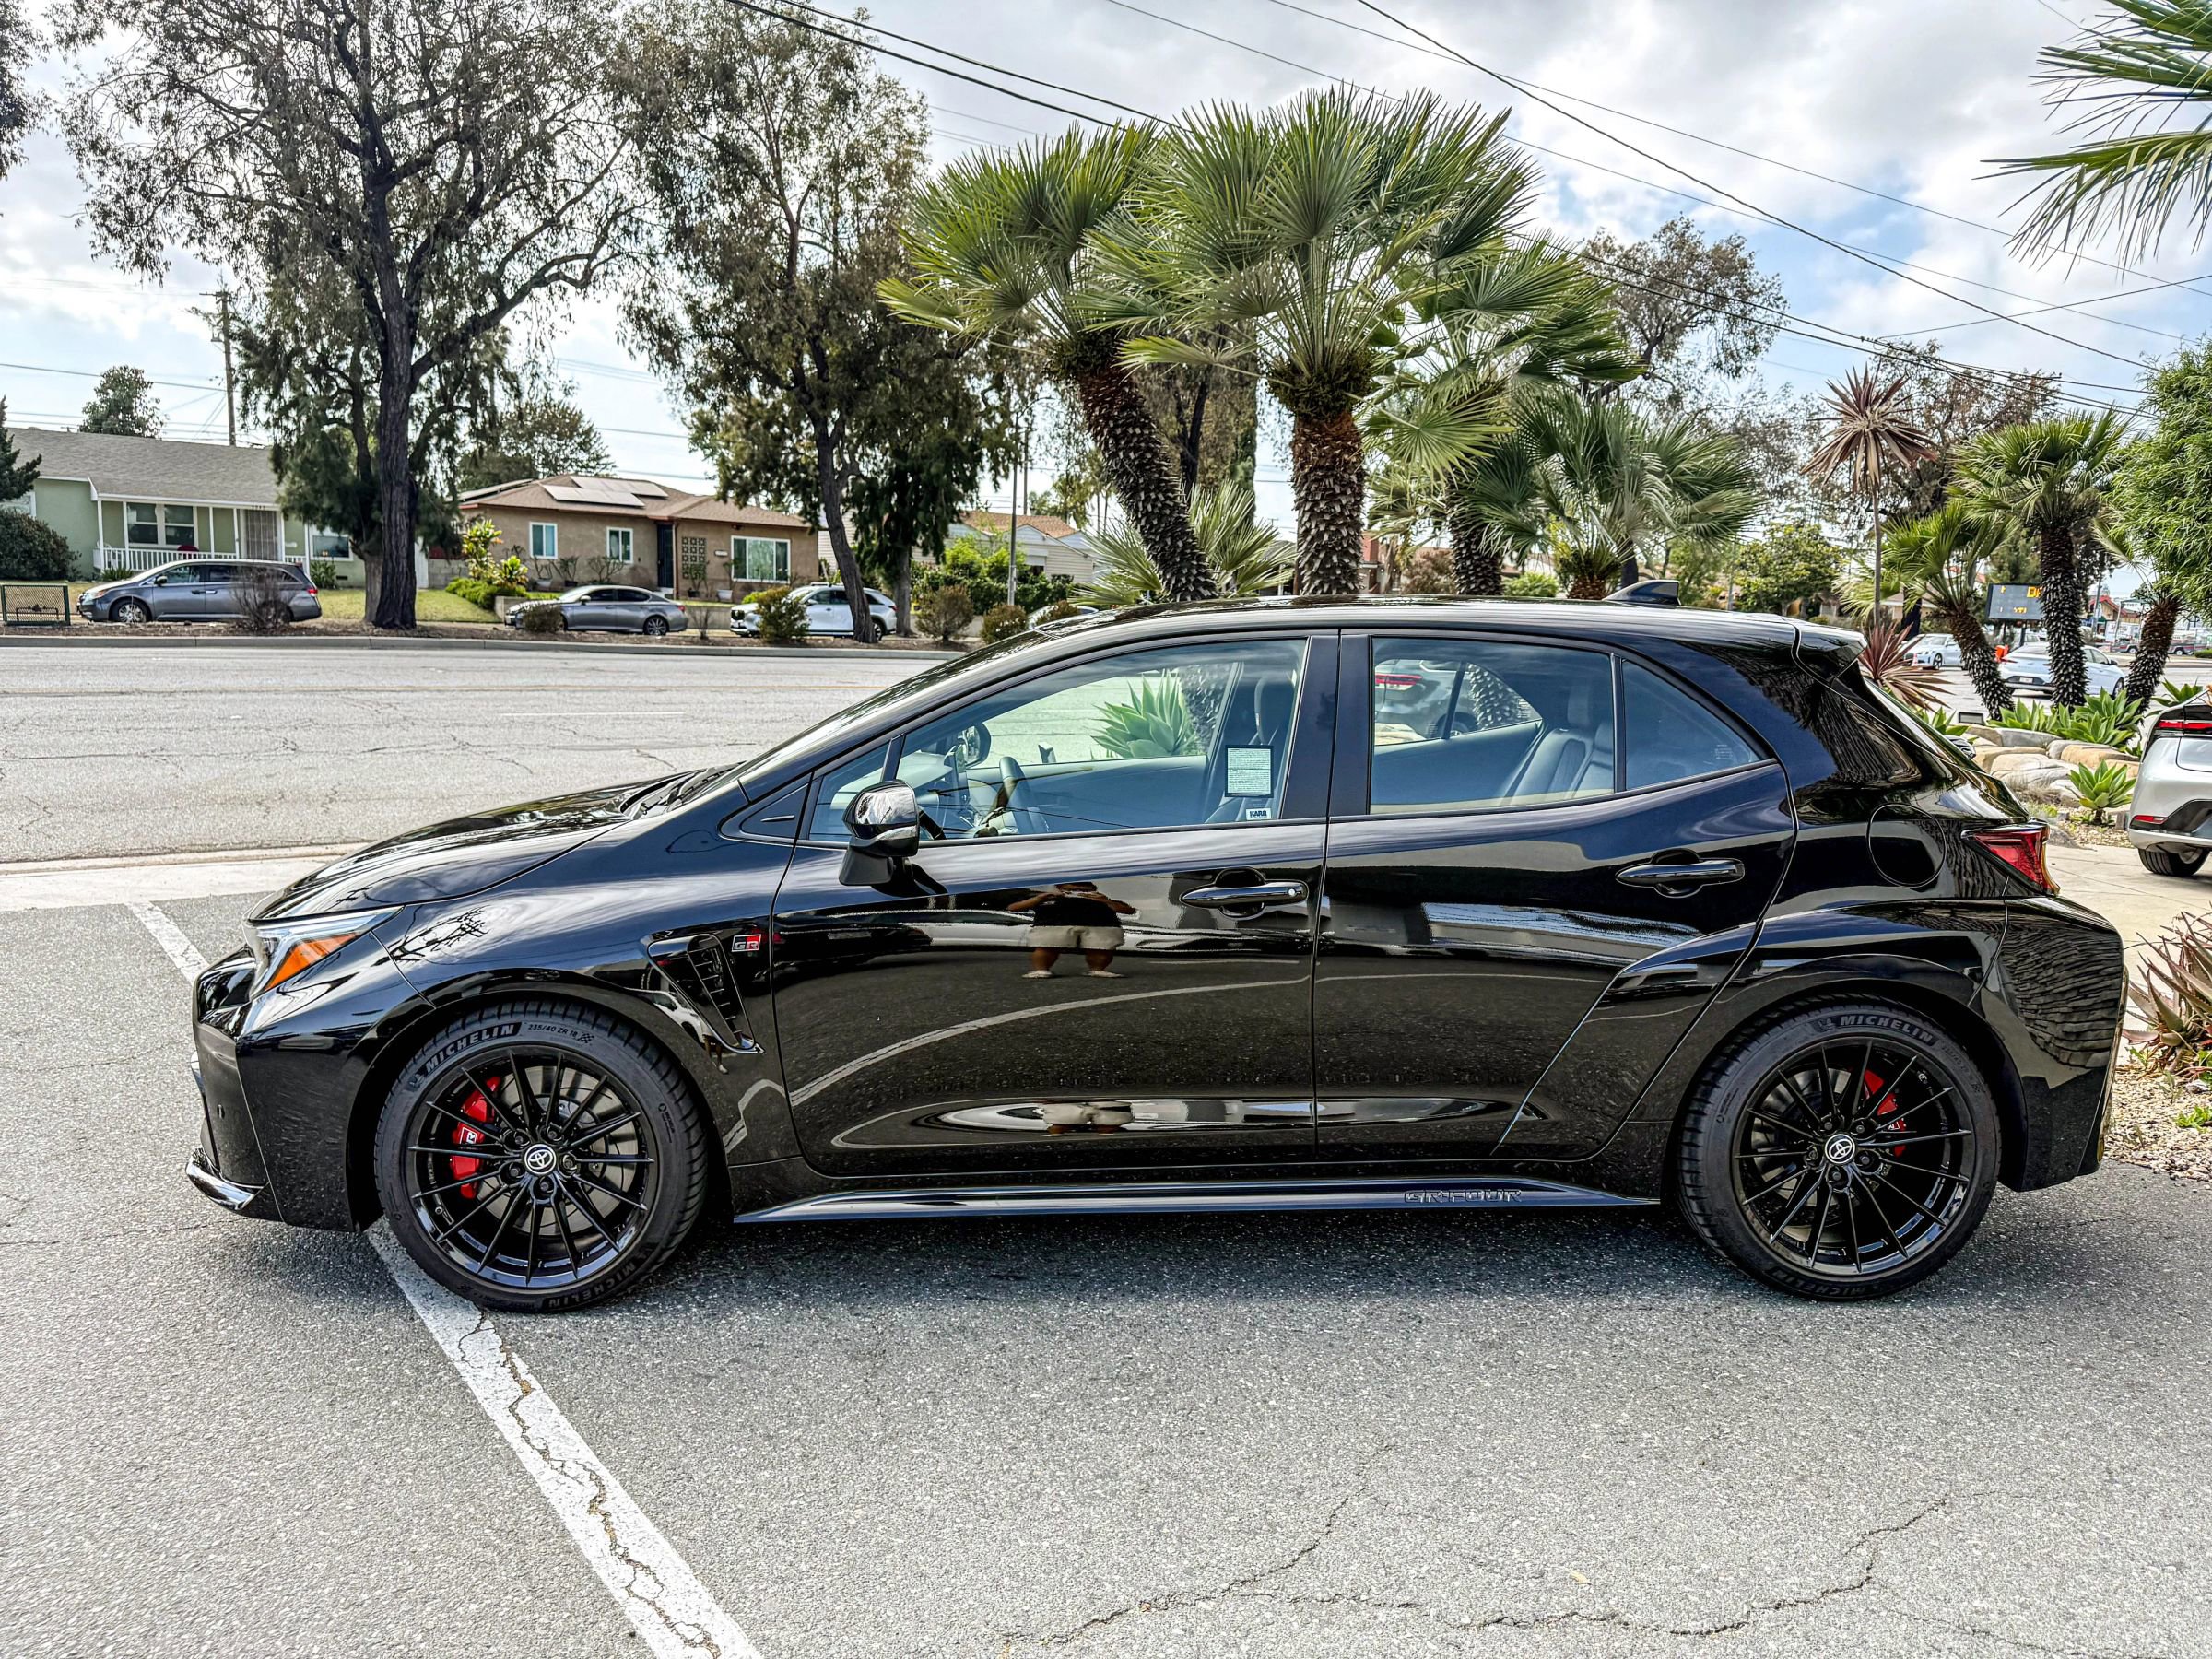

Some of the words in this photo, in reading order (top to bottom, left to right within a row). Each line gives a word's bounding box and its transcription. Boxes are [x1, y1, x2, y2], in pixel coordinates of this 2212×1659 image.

[425, 1023, 514, 1072] MICHELIN
[1841, 1015, 1933, 1043] MICHELIN
[548, 1262, 636, 1307] MICHELIN
